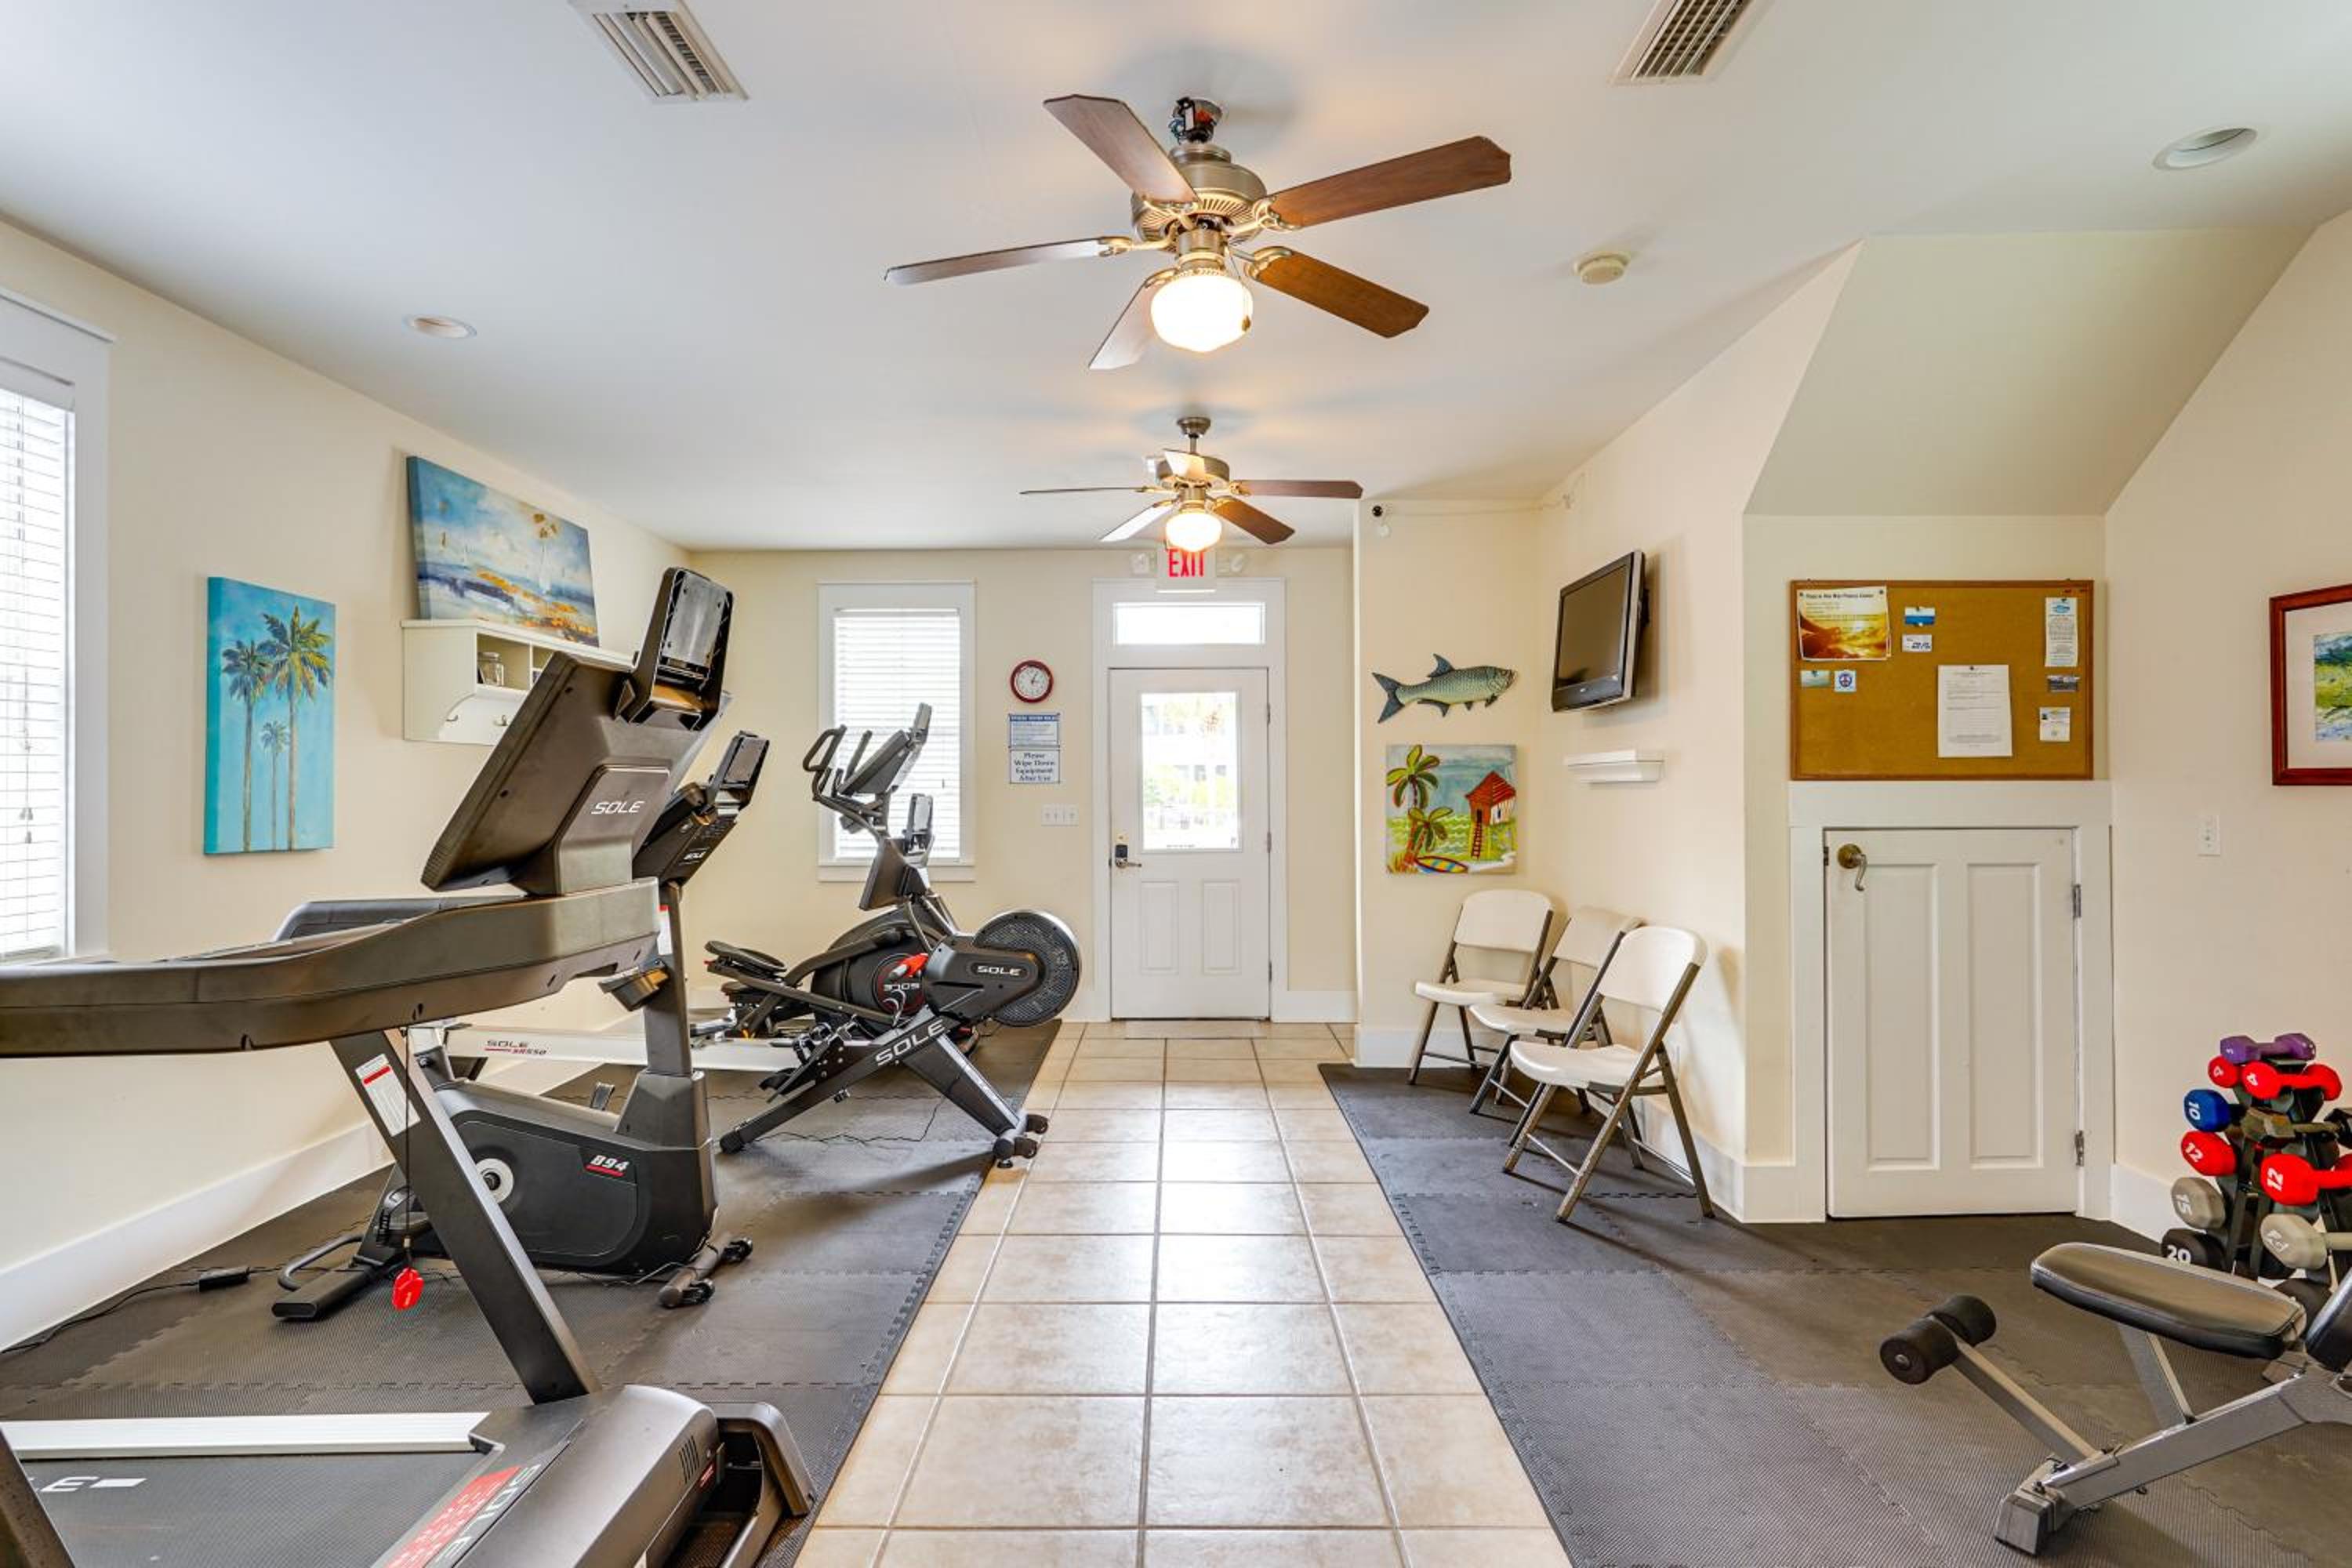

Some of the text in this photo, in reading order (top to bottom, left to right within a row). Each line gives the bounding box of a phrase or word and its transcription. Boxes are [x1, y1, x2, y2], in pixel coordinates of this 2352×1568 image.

[1168, 547, 1204, 577] EXIT
[590, 800, 645, 815] SOLE
[977, 965, 1022, 977] SOLE
[487, 1040, 528, 1048] SOLE
[875, 1019, 946, 1067] SOLE
[2187, 1102, 2201, 1121] 10
[2184, 1142, 2205, 1163] 12
[2266, 1167, 2285, 1192] 12
[2175, 1193, 2194, 1216] 15
[2167, 1244, 2193, 1265] 20
[434, 1464, 543, 1563] SOLE
